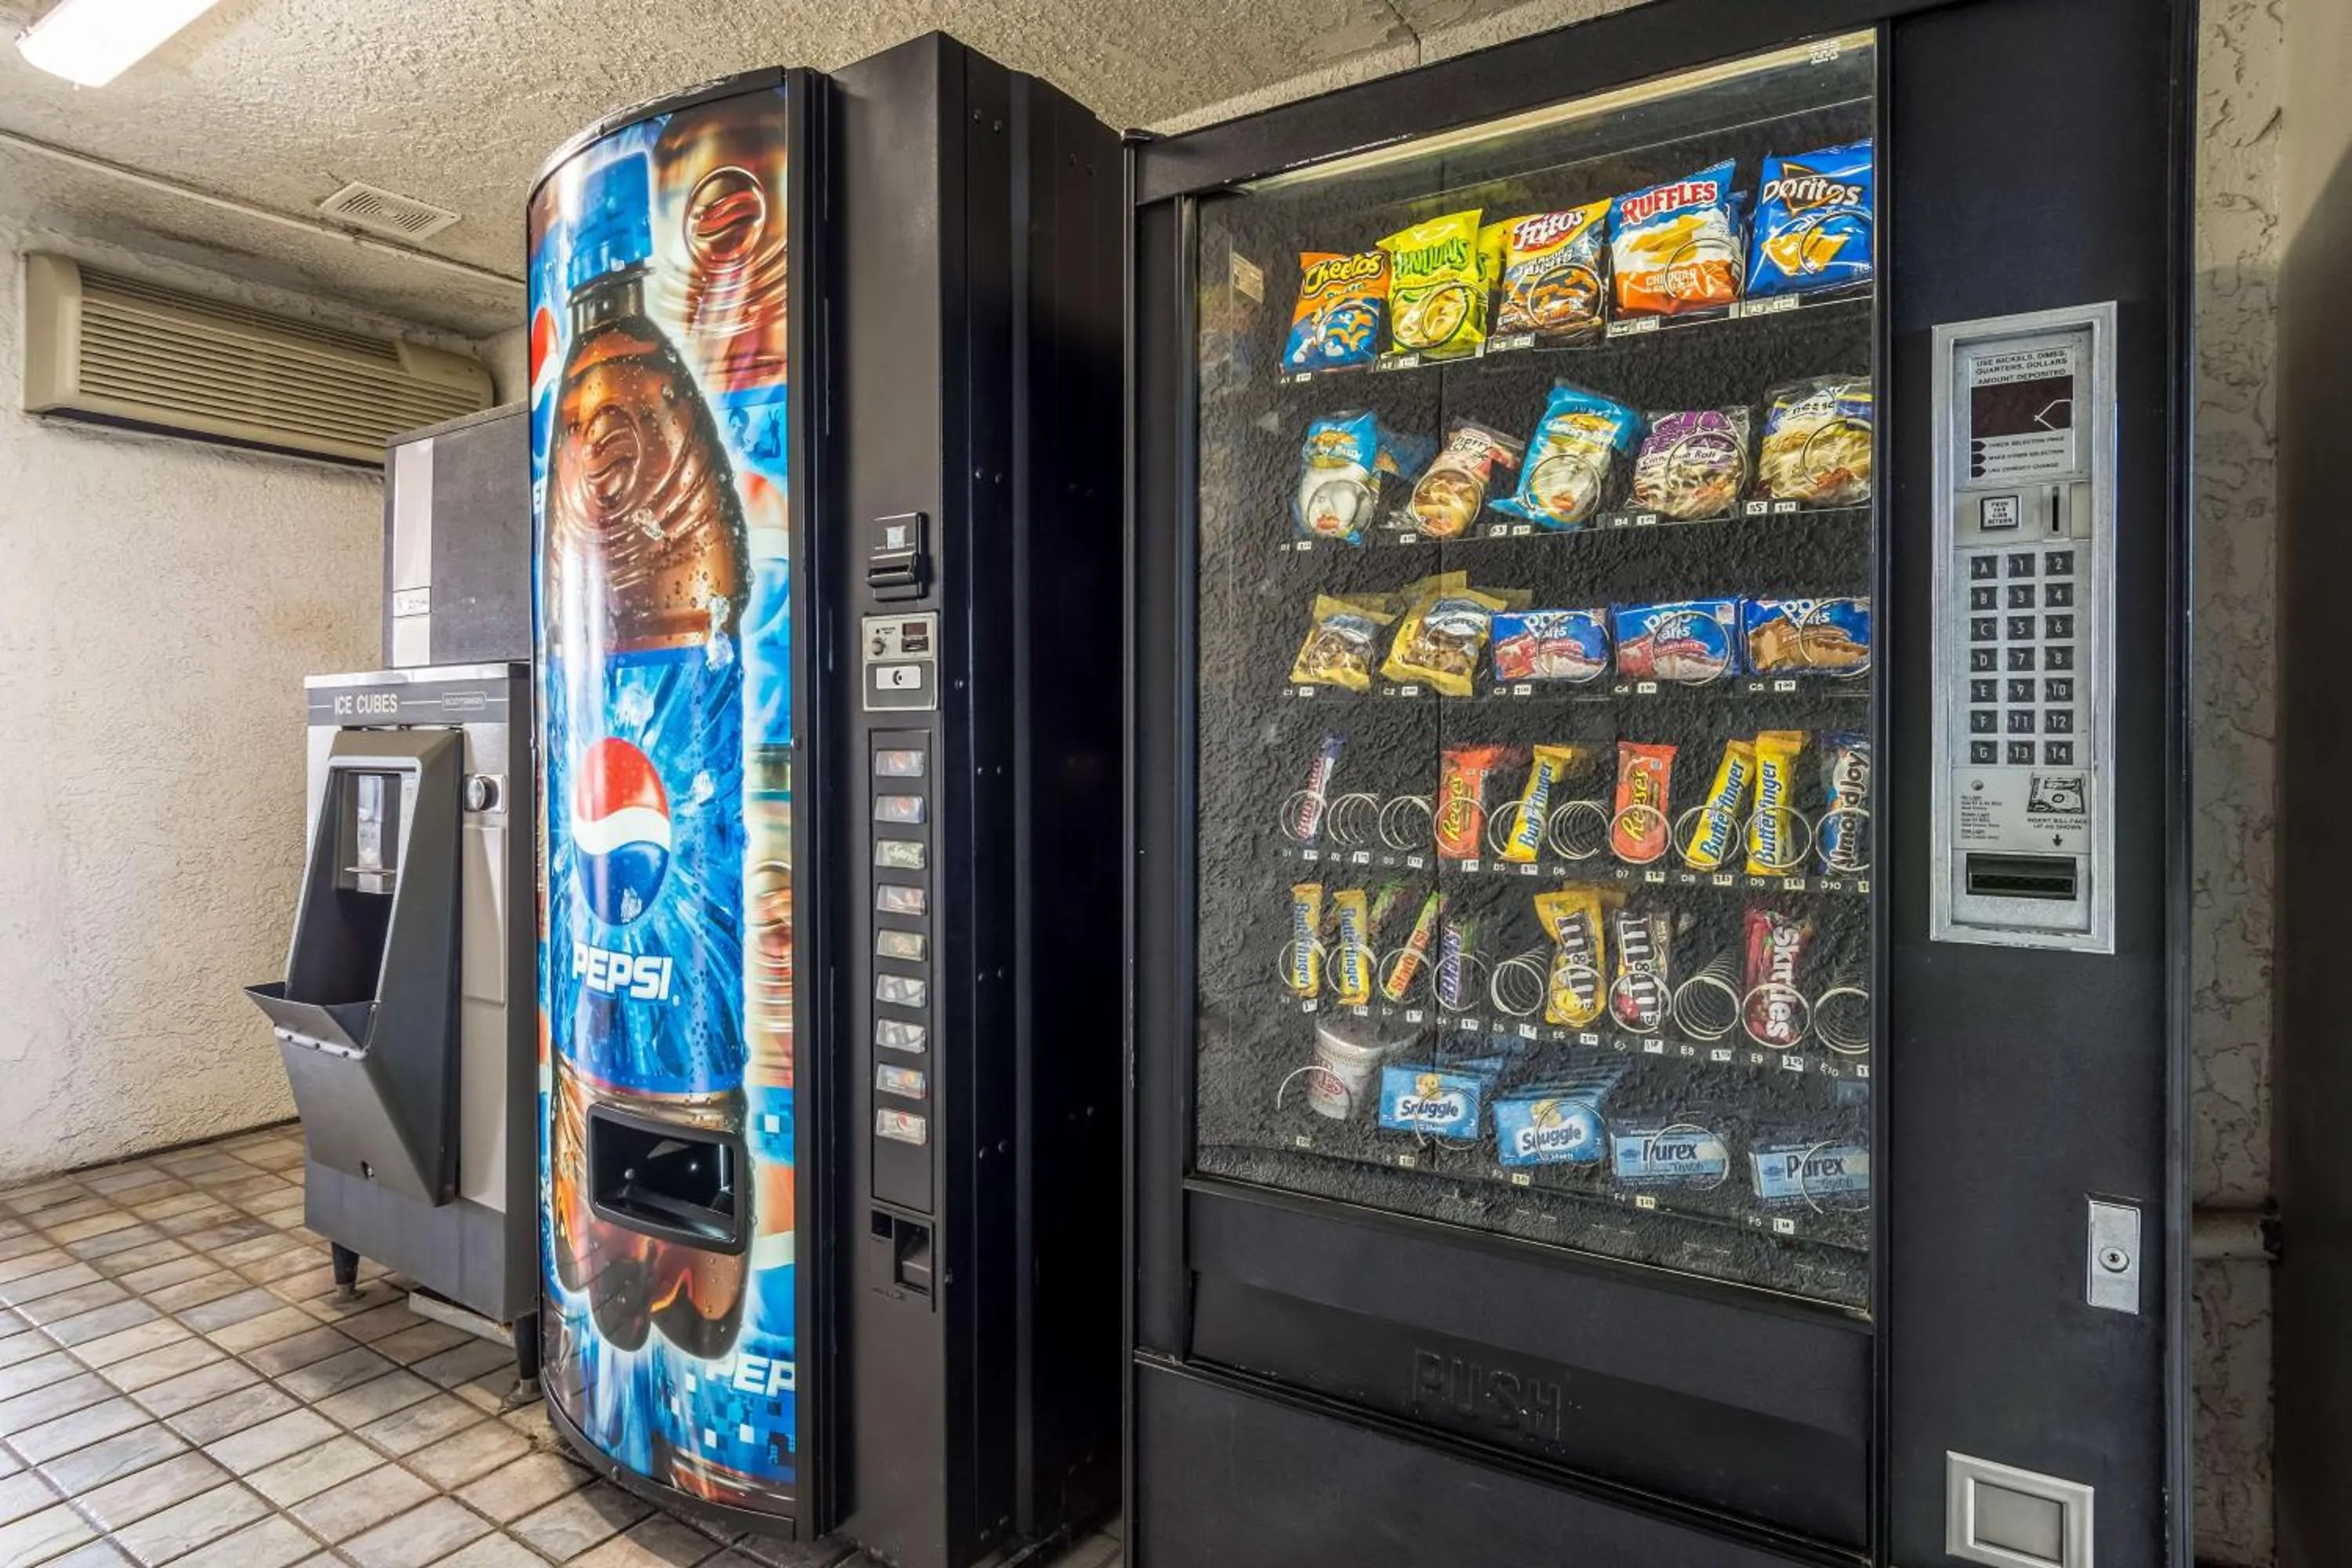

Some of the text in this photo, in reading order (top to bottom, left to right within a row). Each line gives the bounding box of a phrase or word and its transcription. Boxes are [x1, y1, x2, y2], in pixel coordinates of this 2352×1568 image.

[1762, 178, 1863, 205] Doritos
[1621, 181, 1716, 224] RUFFLES
[1514, 210, 1585, 249] Fritos
[1305, 253, 1384, 295] Cheetos
[2027, 358, 2067, 368] DOLLARS
[1979, 368, 2066, 384] AMOUNT DEPOSITED
[1980, 562, 1987, 574] A
[2019, 560, 2024, 571] 1
[2056, 557, 2063, 570] 2
[1980, 593, 1987, 604] B
[2017, 591, 2024, 602] 3
[2055, 589, 2063, 601] 4
[1981, 623, 1987, 635] C
[2017, 622, 2024, 634] 5
[2055, 620, 2062, 633] 6
[1980, 655, 1987, 666] D
[2018, 654, 2025, 665] 7
[2055, 653, 2062, 664] 8
[1981, 685, 1987, 696] E
[2017, 685, 2024, 697] 9
[2053, 684, 2067, 696] 10
[335, 694, 397, 715] ICE CUBES
[1981, 716, 1987, 728] F
[2014, 717, 2028, 728] 11
[2053, 716, 2067, 728] 12
[1980, 747, 1987, 758] G
[2015, 747, 2028, 759] 13
[2052, 746, 2067, 758] 14
[1840, 750, 1870, 793] Joy
[1518, 762, 1552, 848] Buttfinger
[1553, 867, 1565, 876] D6
[1617, 869, 1629, 878] D7
[572, 941, 673, 1000] PEPSI
[1681, 1046, 1694, 1055] E8
[1751, 1054, 1763, 1064] E9
[1400, 1100, 1459, 1119] Snuggle
[1642, 1139, 1697, 1161] Purex
[1787, 1155, 1845, 1179] Purex
